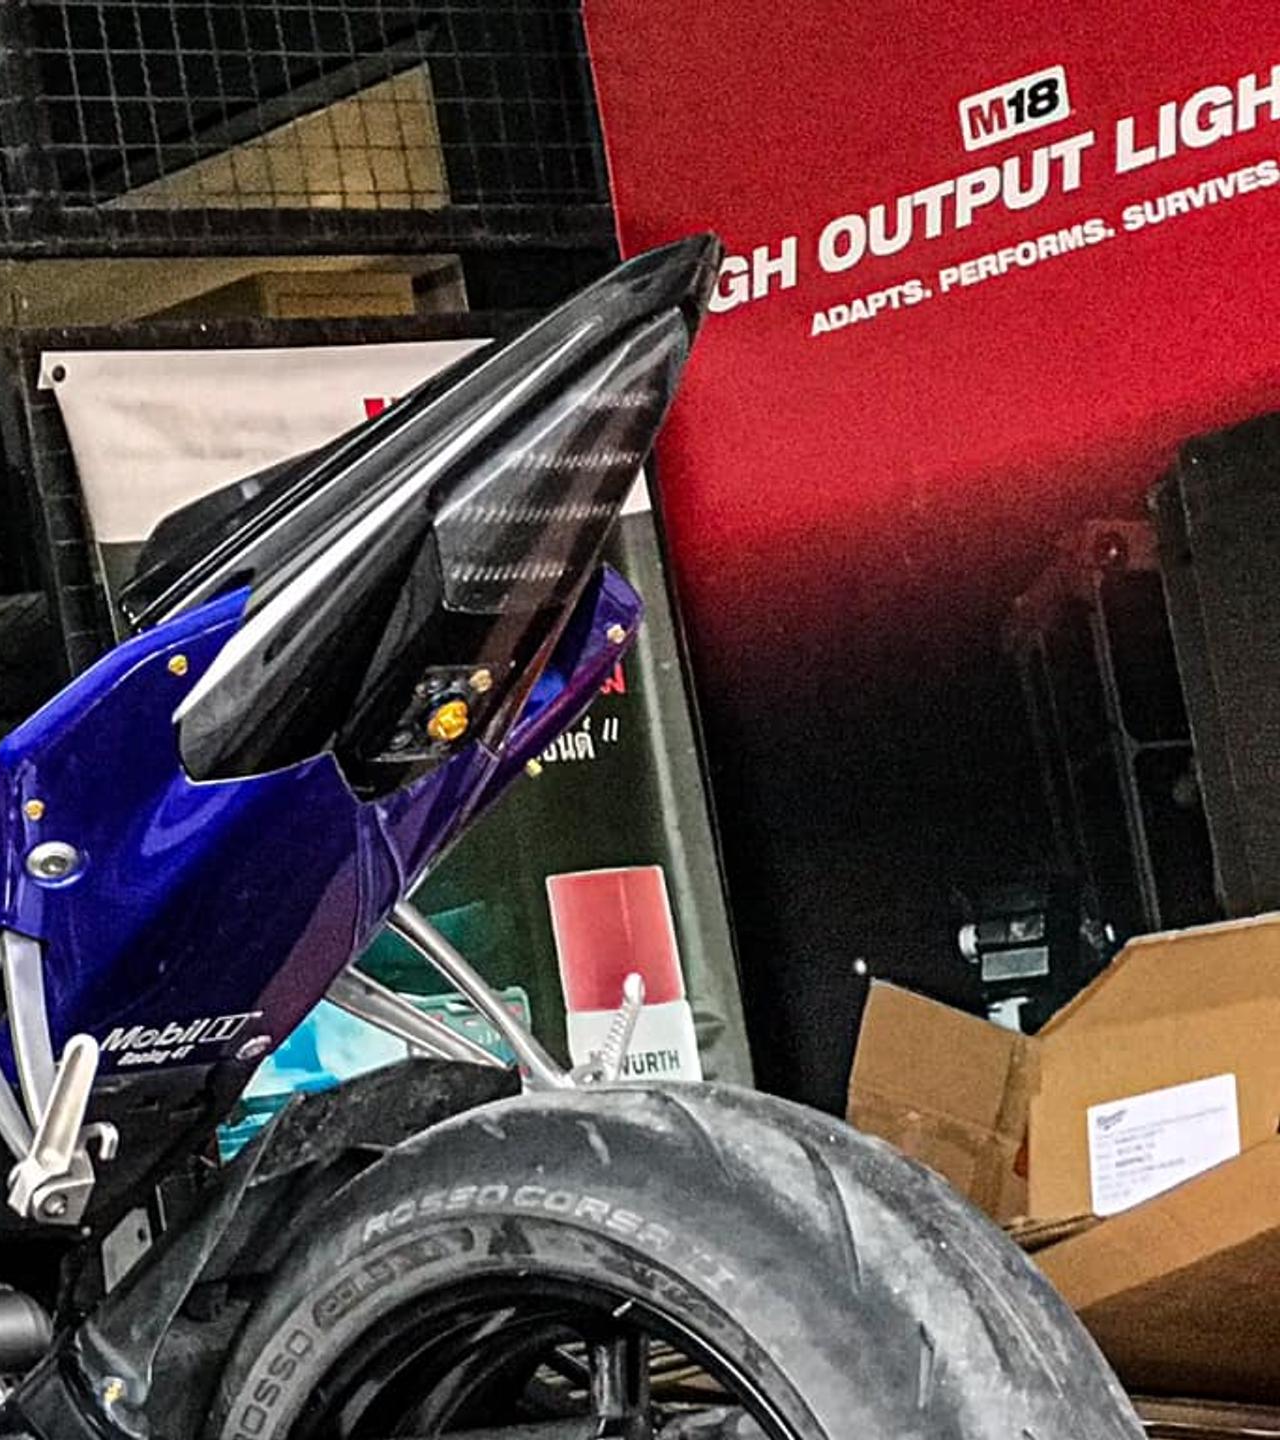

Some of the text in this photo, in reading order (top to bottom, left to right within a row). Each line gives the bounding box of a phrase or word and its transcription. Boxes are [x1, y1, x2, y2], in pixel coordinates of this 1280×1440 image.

[967, 77, 1060, 141] M18
[708, 236, 797, 313] GH
[819, 131, 1095, 273] OUTPUT
[811, 280, 932, 335] ADAPTS.
[939, 219, 1115, 294] PERFORMS.
[100, 1018, 210, 1051] Mobil
